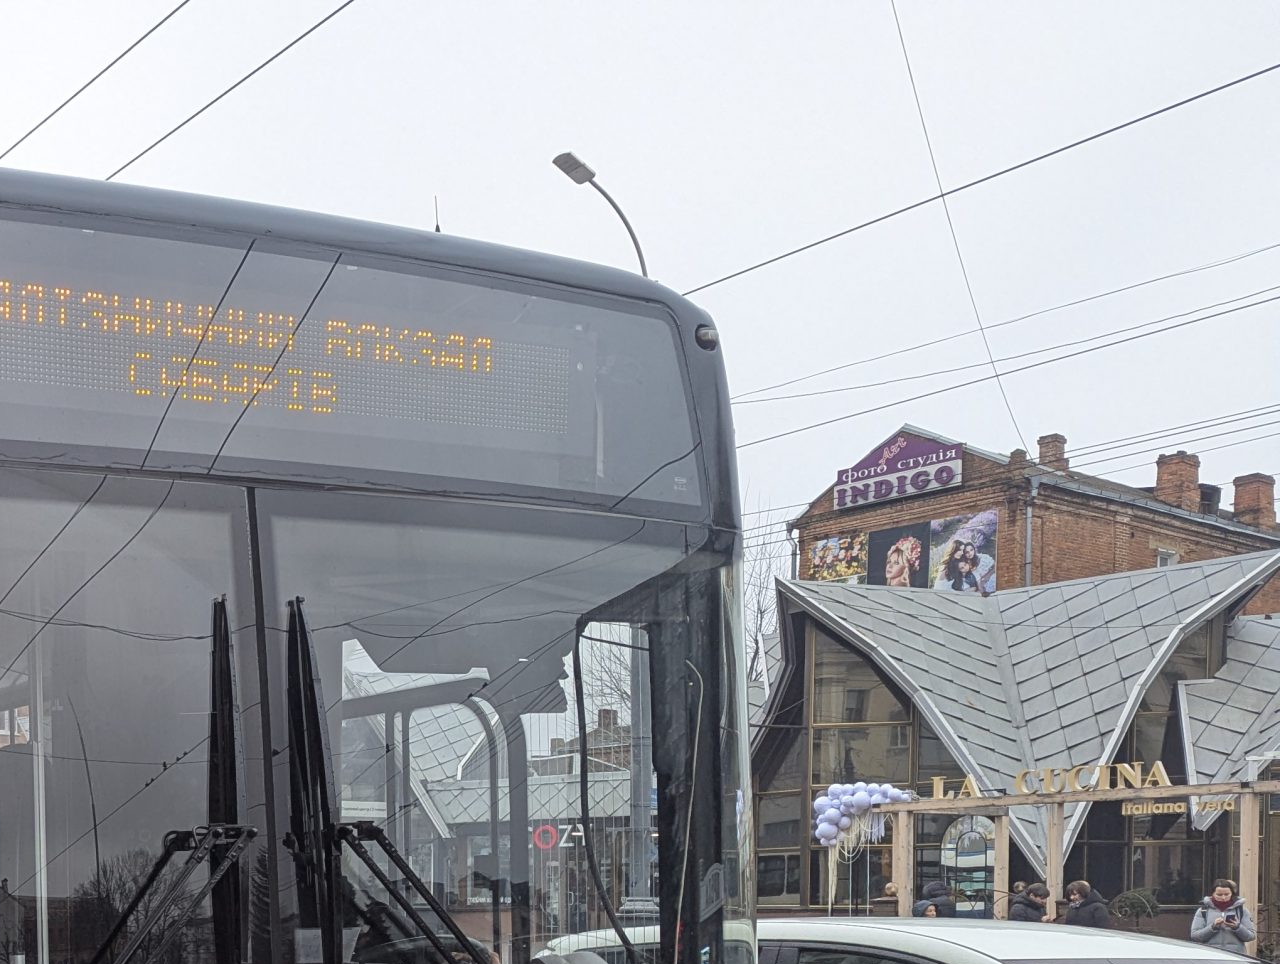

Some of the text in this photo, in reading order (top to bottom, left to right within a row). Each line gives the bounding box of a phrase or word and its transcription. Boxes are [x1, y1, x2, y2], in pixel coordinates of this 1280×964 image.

[897, 449, 957, 469] студія
[836, 465, 955, 507] INDIGO
[931, 760, 1173, 799] LA CUCINA
